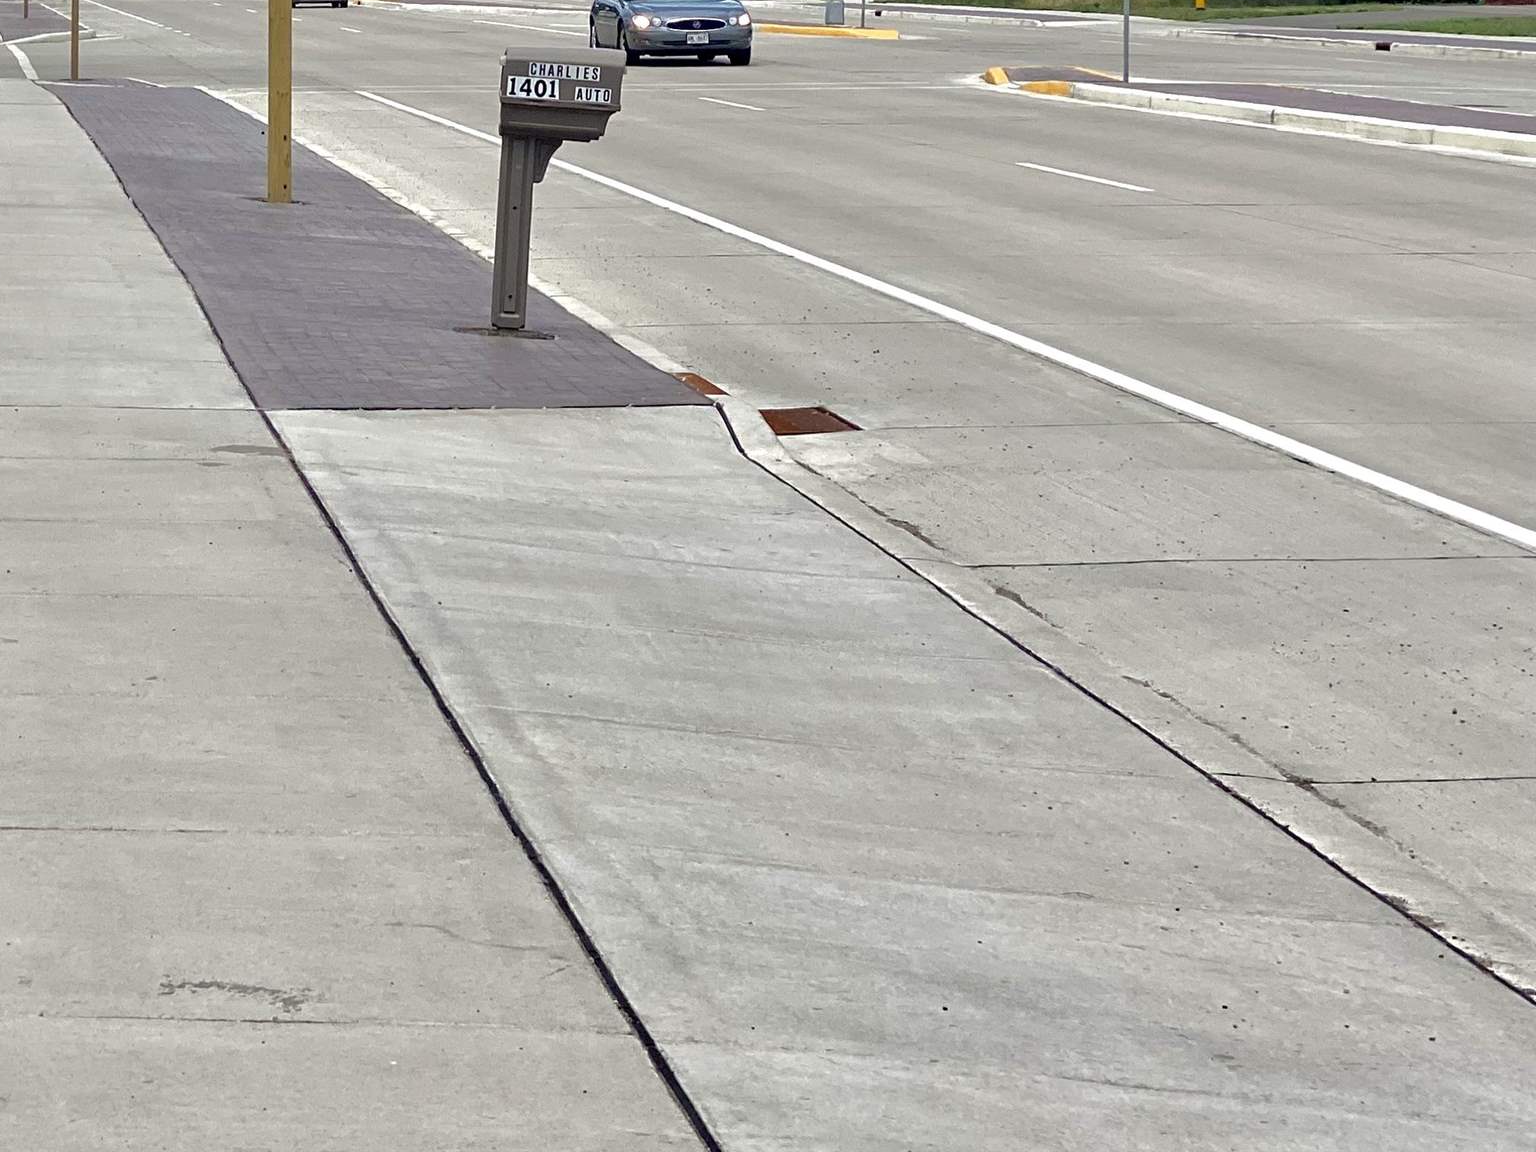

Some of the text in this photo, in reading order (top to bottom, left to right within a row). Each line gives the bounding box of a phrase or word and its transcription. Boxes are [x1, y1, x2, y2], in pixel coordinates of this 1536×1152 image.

[530, 63, 599, 80] CHARLIES
[508, 77, 611, 103] 1401 AUTO
